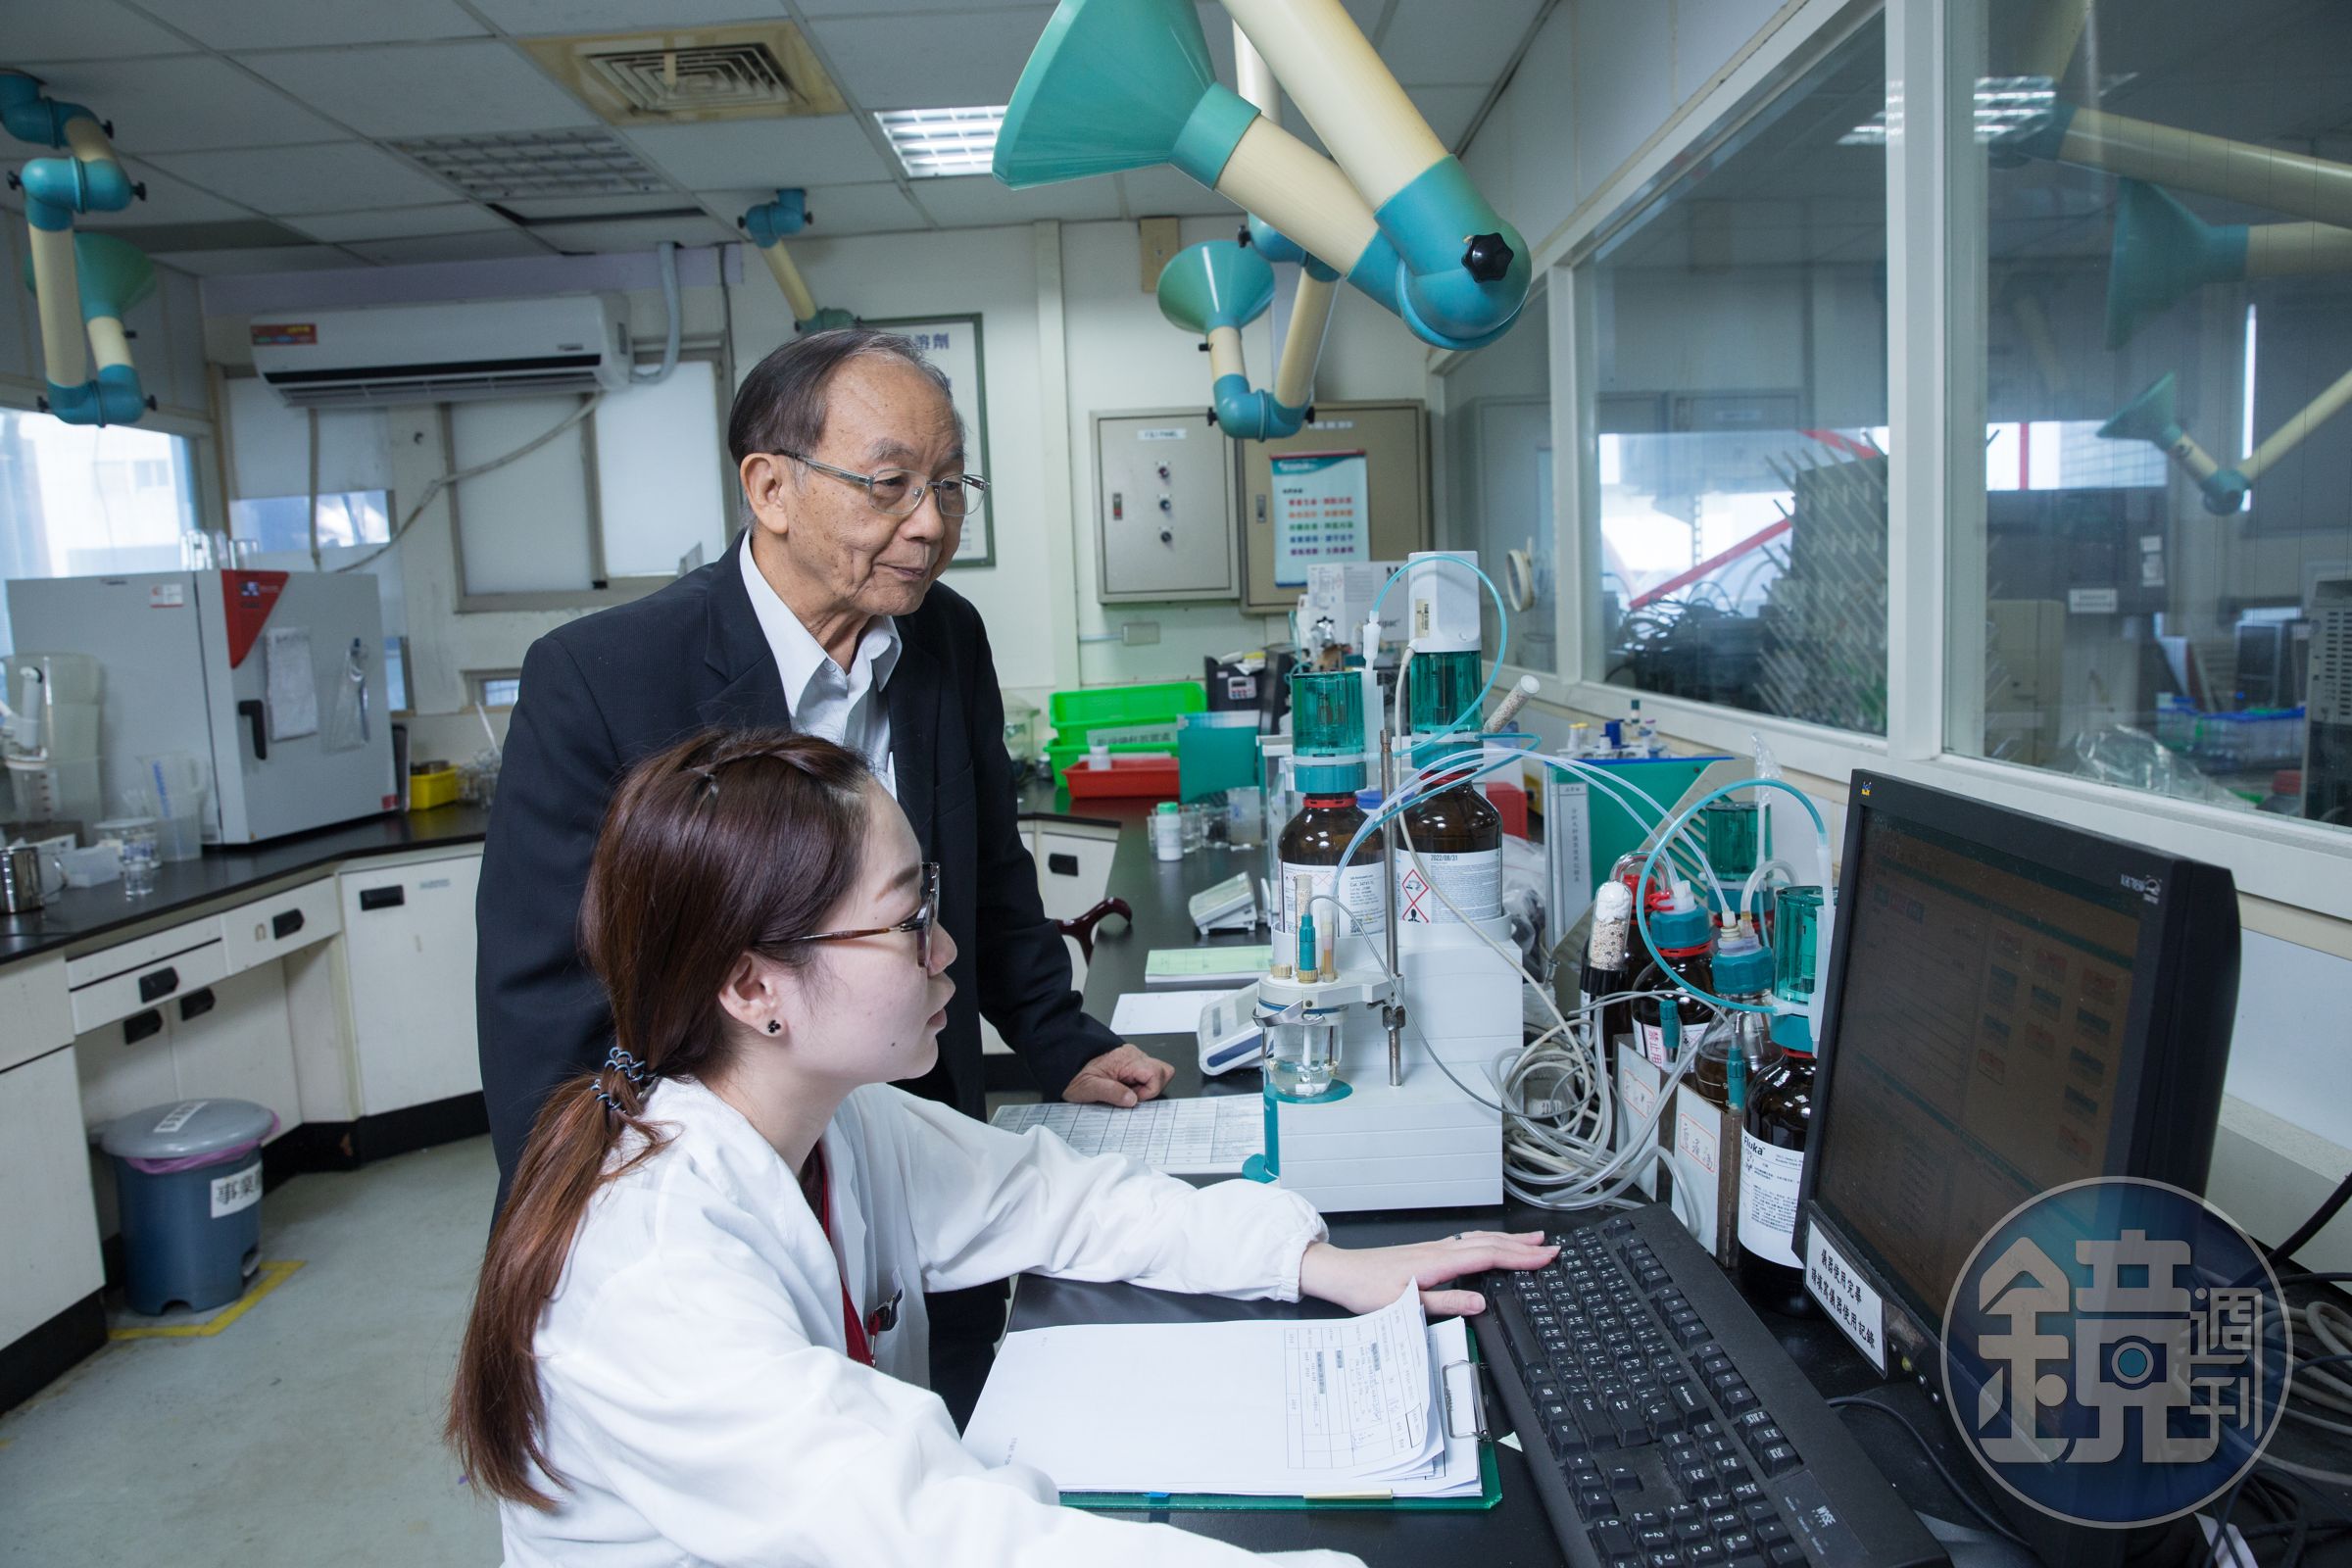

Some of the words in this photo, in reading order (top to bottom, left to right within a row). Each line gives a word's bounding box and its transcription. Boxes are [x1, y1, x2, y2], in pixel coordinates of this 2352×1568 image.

[1820, 1249, 1862, 1306] 儀器使用完畢
